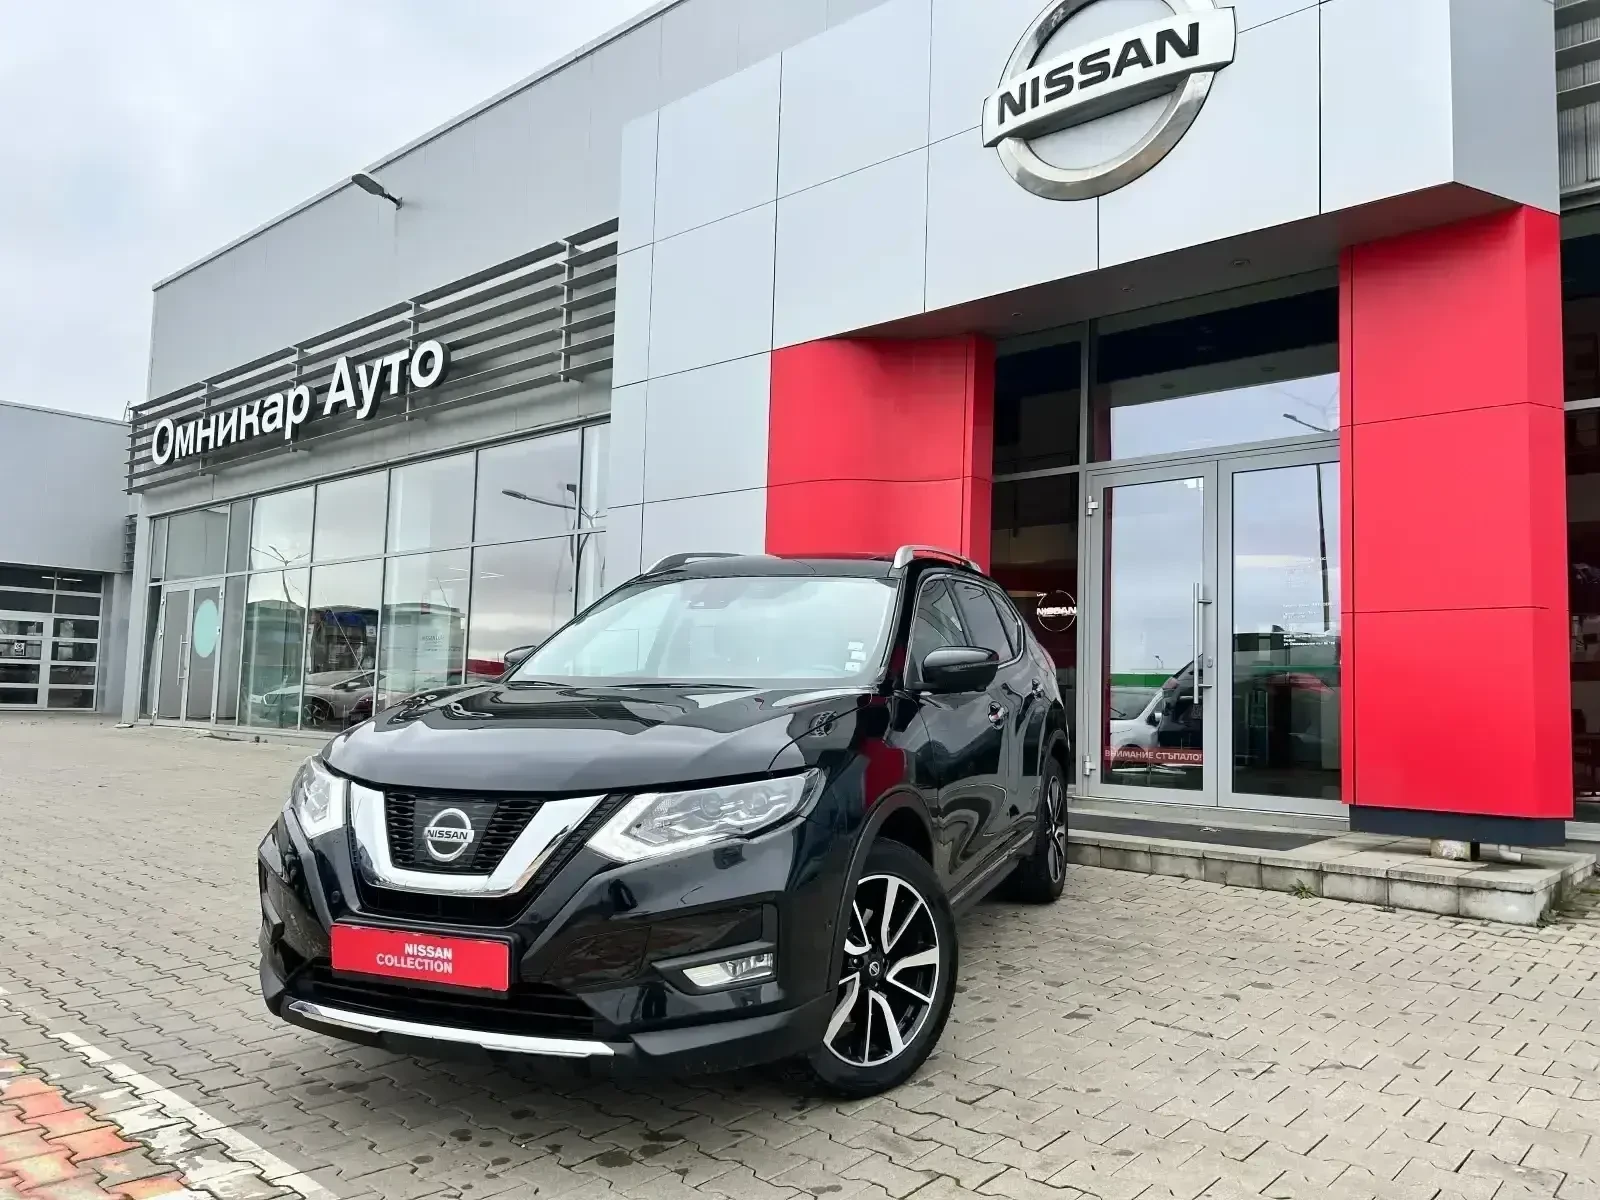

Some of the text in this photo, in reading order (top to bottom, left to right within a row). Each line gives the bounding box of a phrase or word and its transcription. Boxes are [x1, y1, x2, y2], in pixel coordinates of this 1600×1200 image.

[998, 22, 1200, 126] NISSAN
[151, 340, 445, 466] Омникар Ауто
[1036, 606, 1077, 616] NISSAN
[1105, 750, 1202, 761] ВНИМАНИЕ СТЪПАЛО!
[427, 829, 468, 840] NISSAN
[404, 943, 453, 960] NISSAN
[376, 953, 453, 974] COLLECTION
